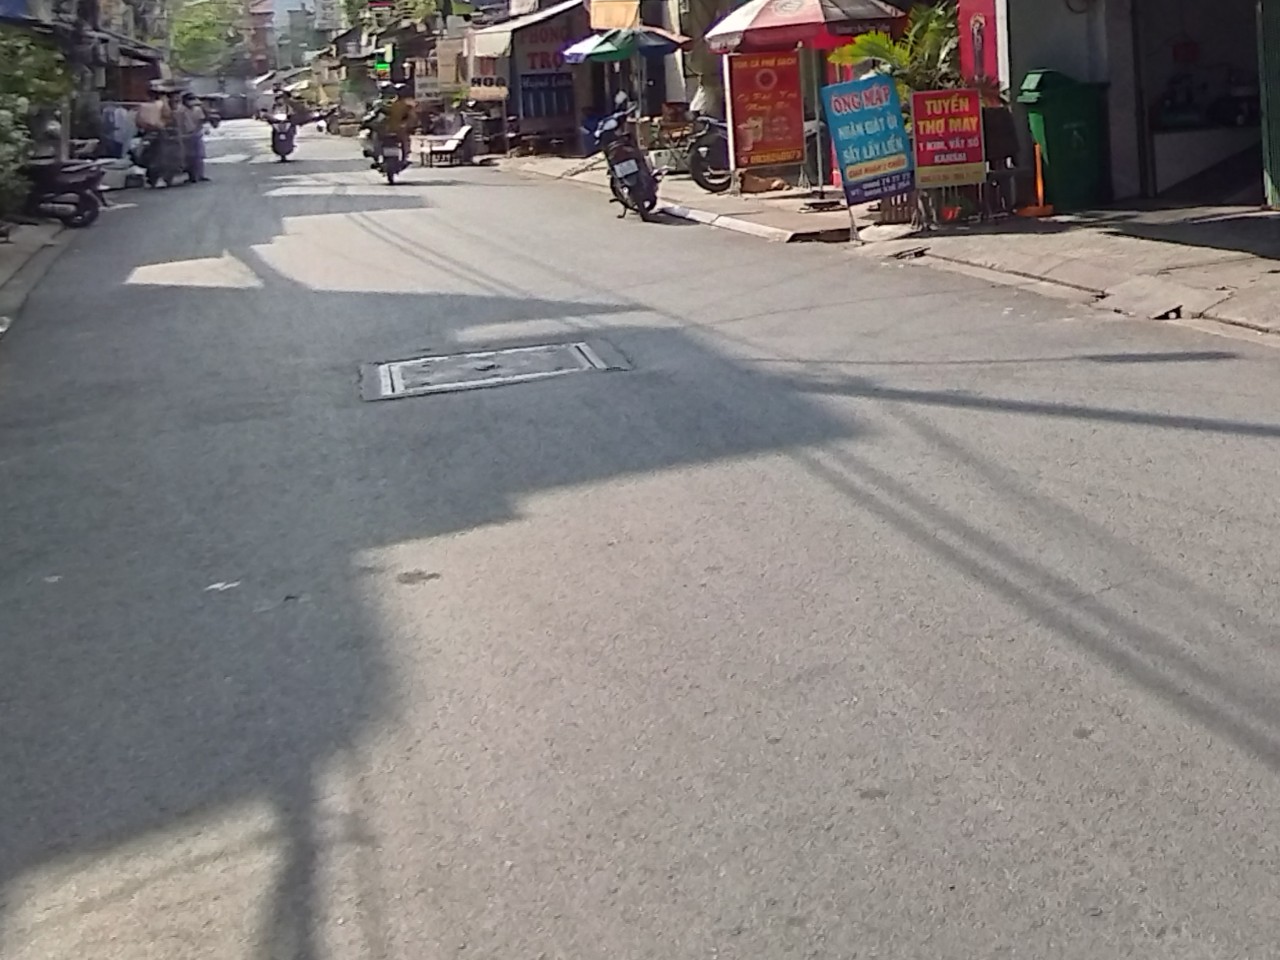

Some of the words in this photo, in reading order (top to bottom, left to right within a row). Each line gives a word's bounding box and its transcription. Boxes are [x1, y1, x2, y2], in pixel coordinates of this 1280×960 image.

[831, 94, 860, 116] ÔNG
[862, 83, 890, 110] MẬP
[925, 93, 970, 116] TUYỂN
[917, 118, 945, 137] THỢ
[948, 116, 978, 133] MAY
